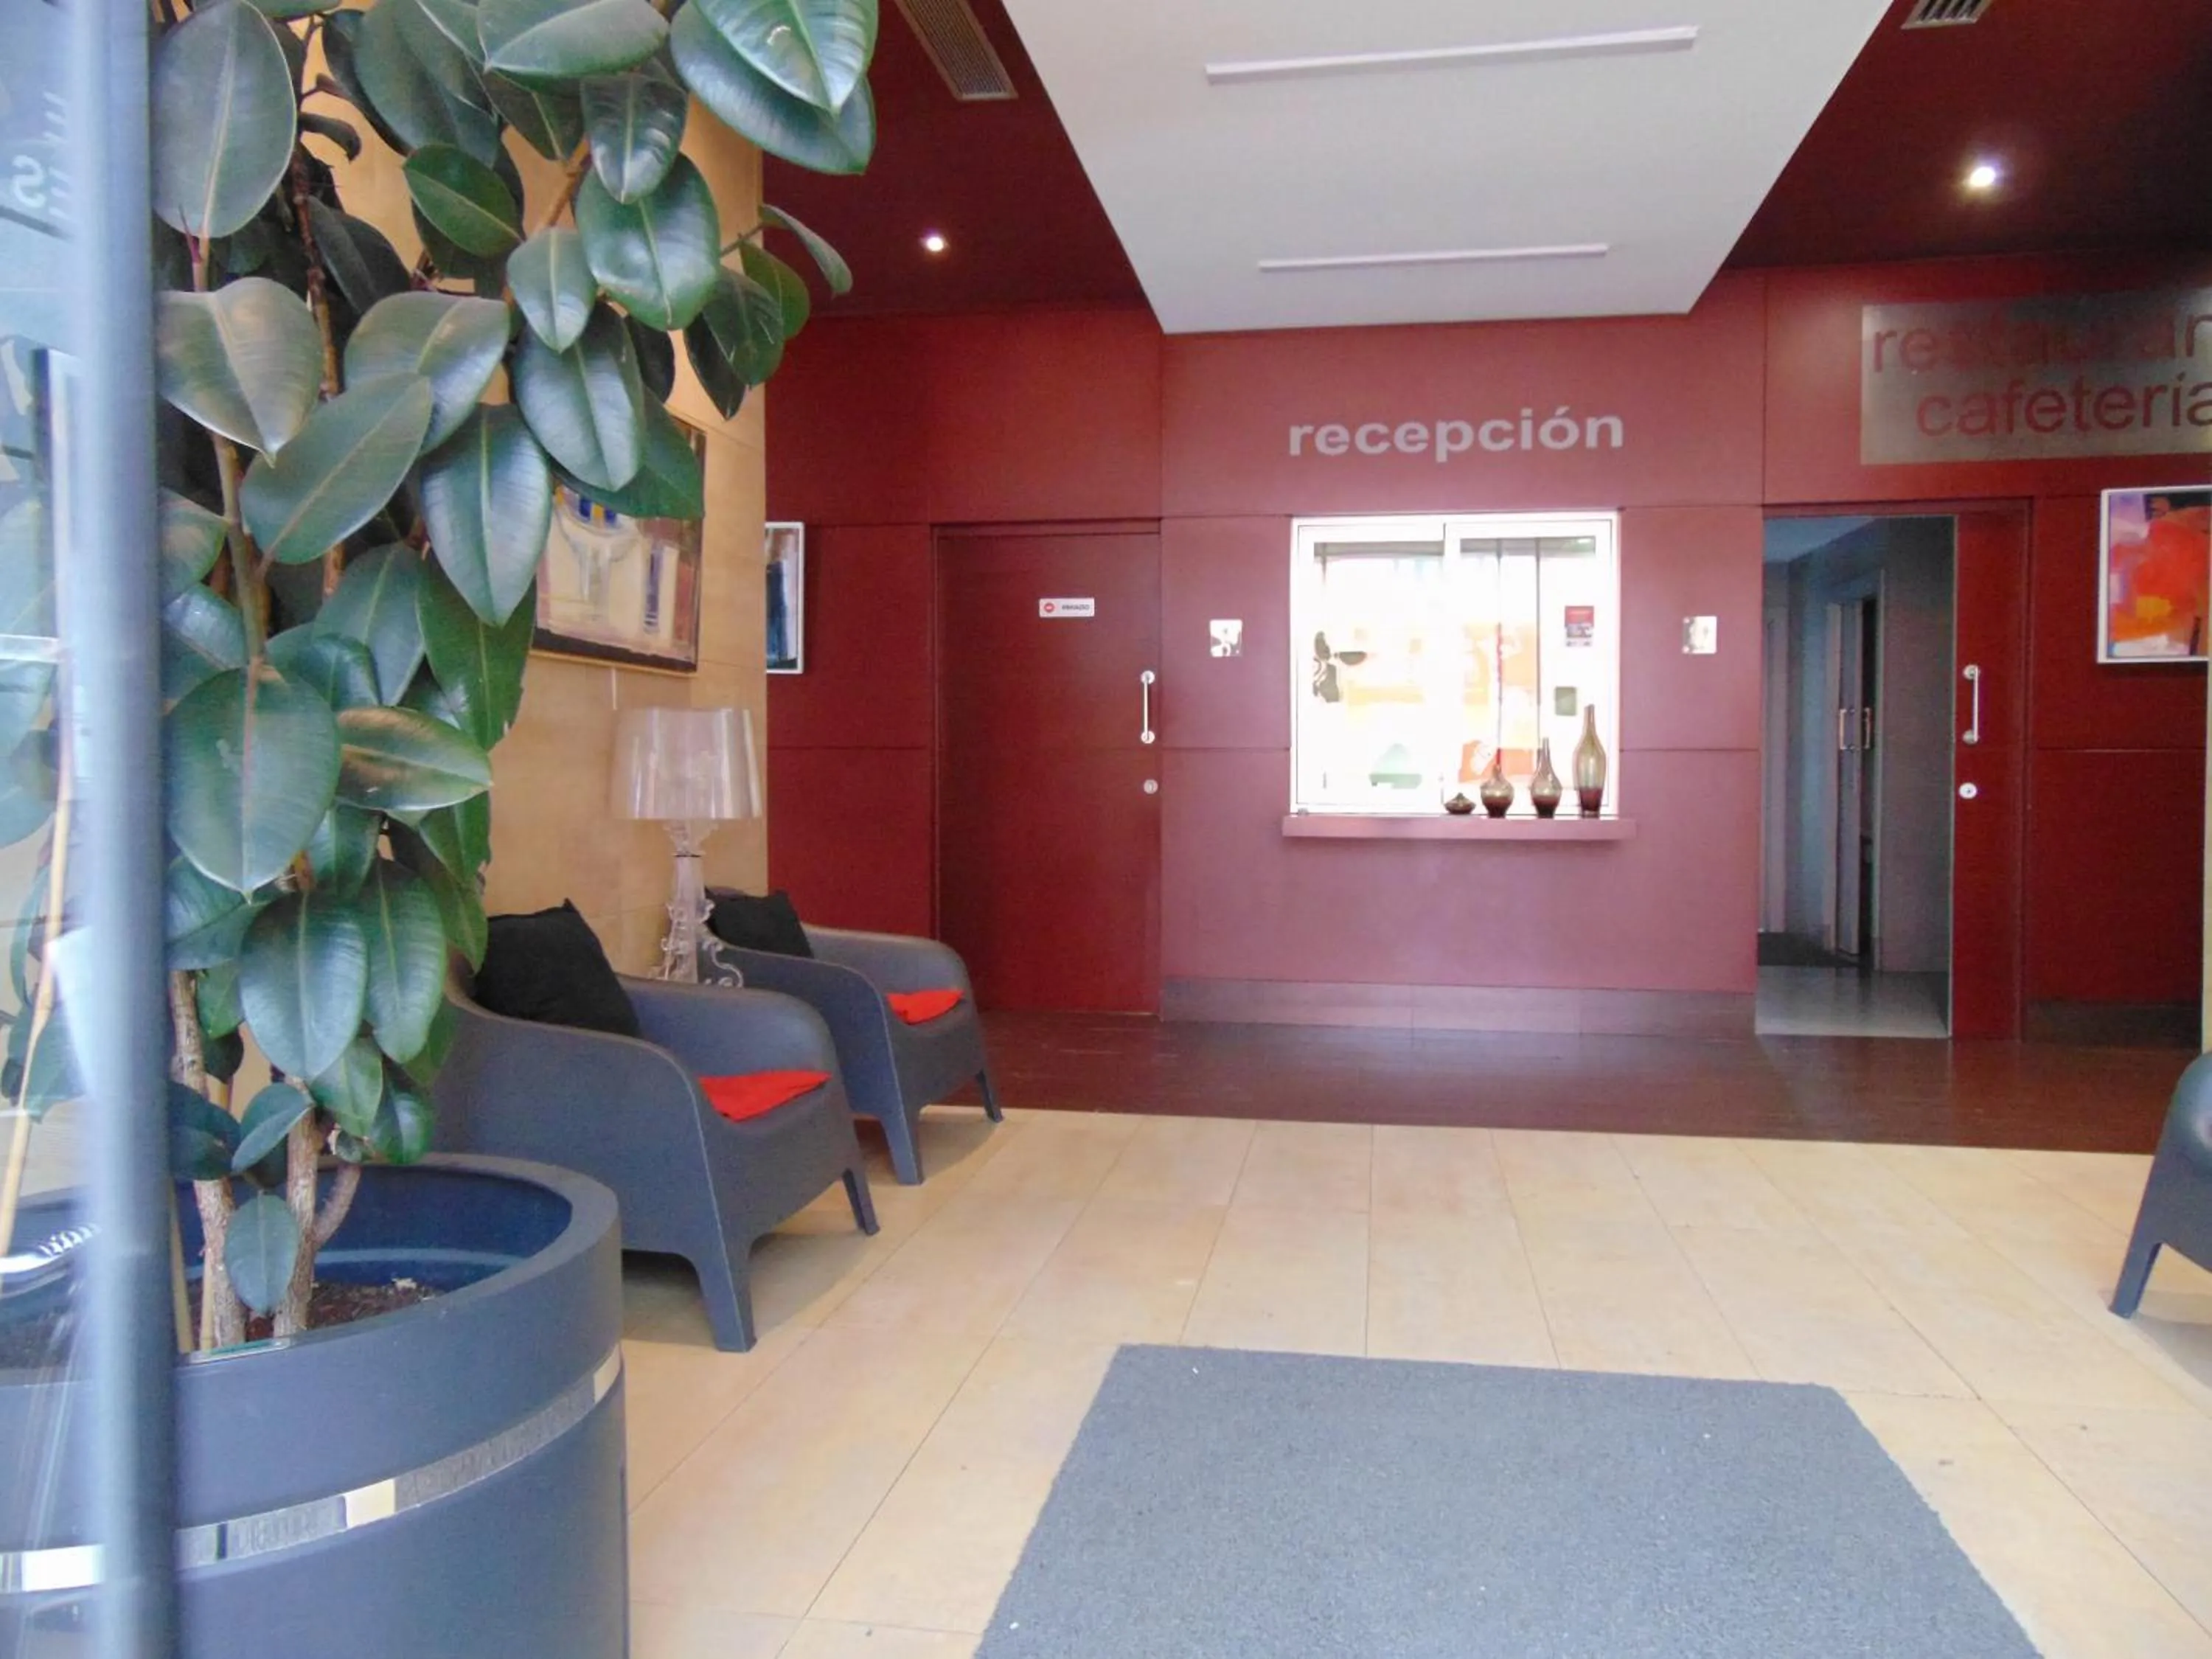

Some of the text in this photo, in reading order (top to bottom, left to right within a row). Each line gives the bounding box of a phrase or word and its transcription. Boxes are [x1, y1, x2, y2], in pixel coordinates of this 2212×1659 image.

[1873, 307, 2212, 373] restauan
[1289, 406, 1624, 463] recepción
[1919, 372, 2212, 437] cafetería
